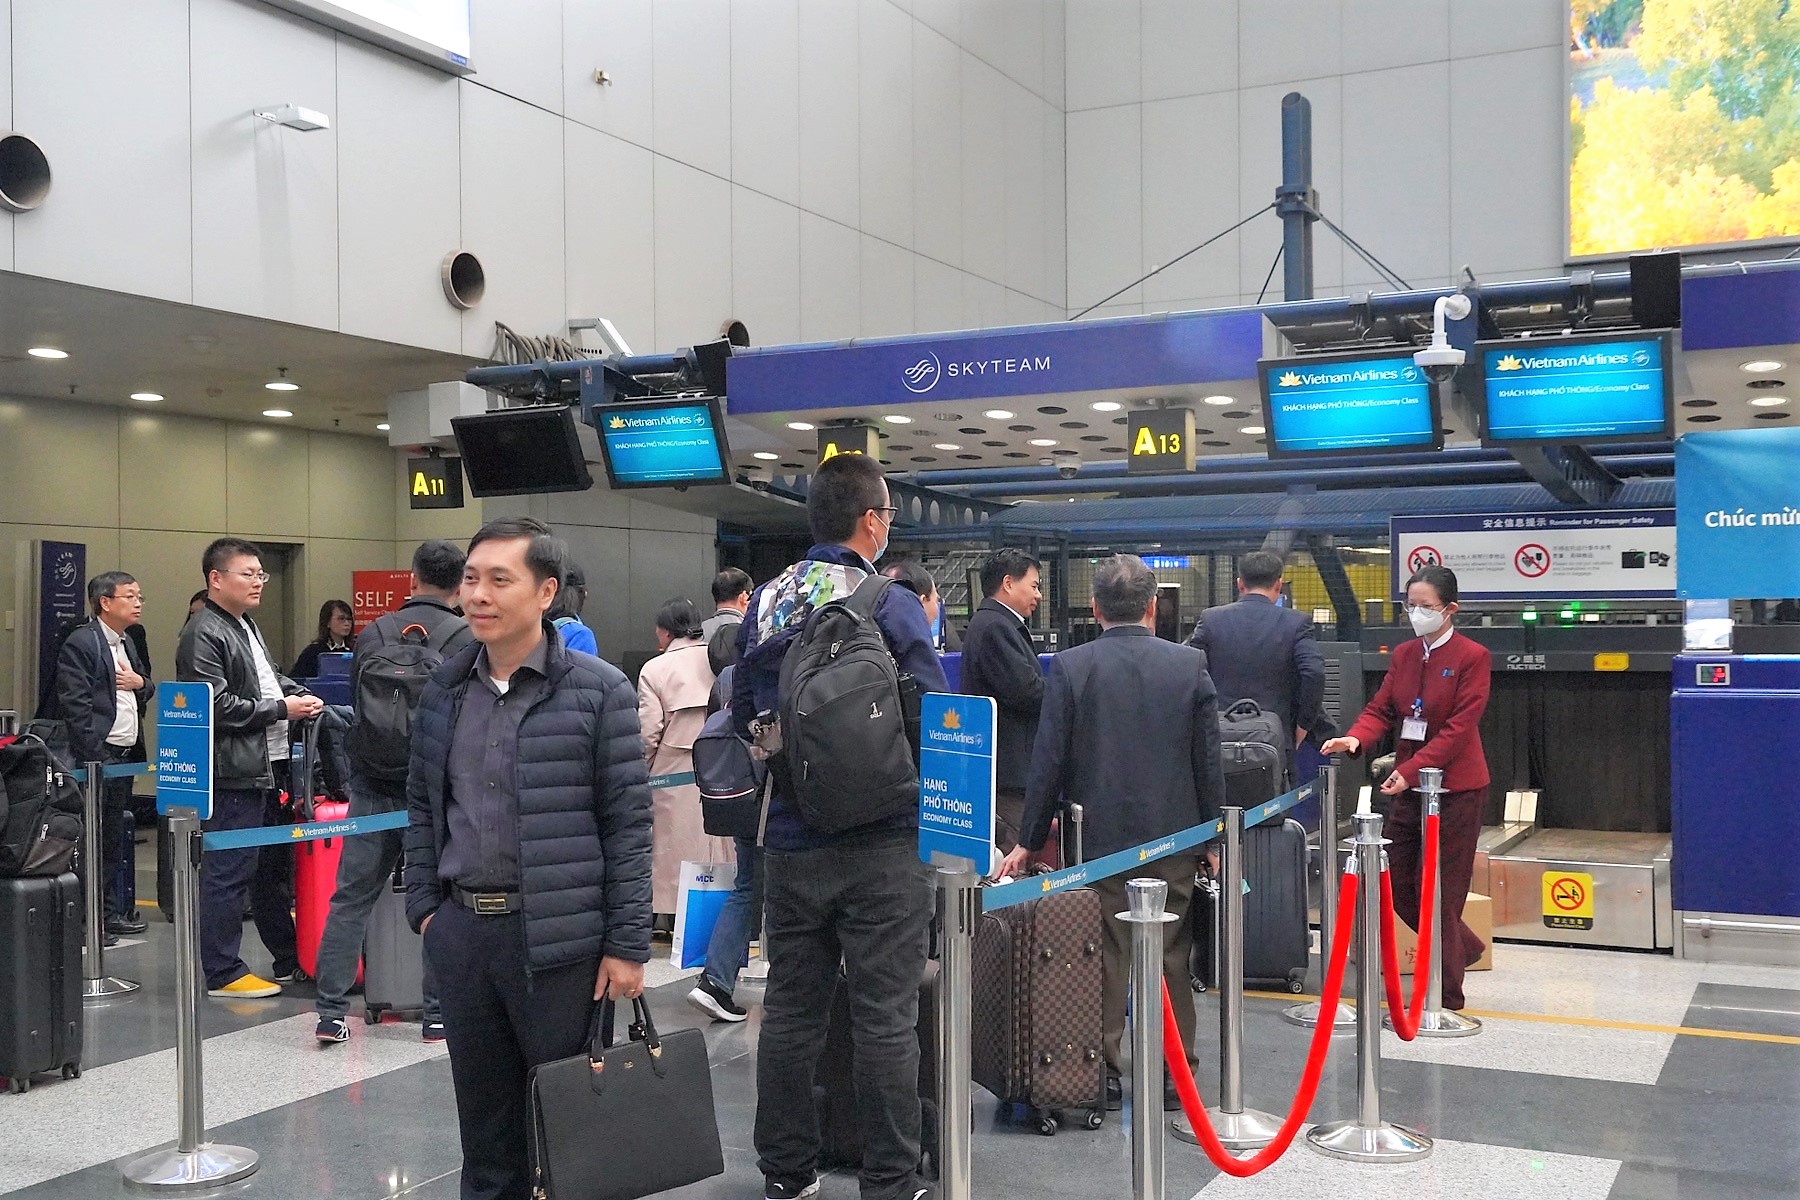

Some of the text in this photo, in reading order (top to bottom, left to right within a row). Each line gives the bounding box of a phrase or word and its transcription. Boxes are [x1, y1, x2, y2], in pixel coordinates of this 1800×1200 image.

[948, 357, 1050, 377] SKYTEAM
[1522, 353, 1628, 369] Vietnam Airlines
[1302, 369, 1398, 385] Vietnam Airlines
[625, 415, 691, 428] Vietnam Airlines
[1549, 518, 1582, 526] Reminder
[1595, 517, 1631, 527] Passenger
[1632, 516, 1654, 525] Safety
[1705, 508, 1756, 528] Chúc
[355, 591, 394, 607] SELF
[929, 729, 974, 745] Vietnam Airlines
[159, 775, 197, 784] ECONOMY CLASS
[923, 777, 947, 793] HẠNG
[942, 798, 972, 815] THÔNG
[923, 812, 973, 829] ECONOMY CLASS
[303, 824, 350, 837] Vietnam Airlines
